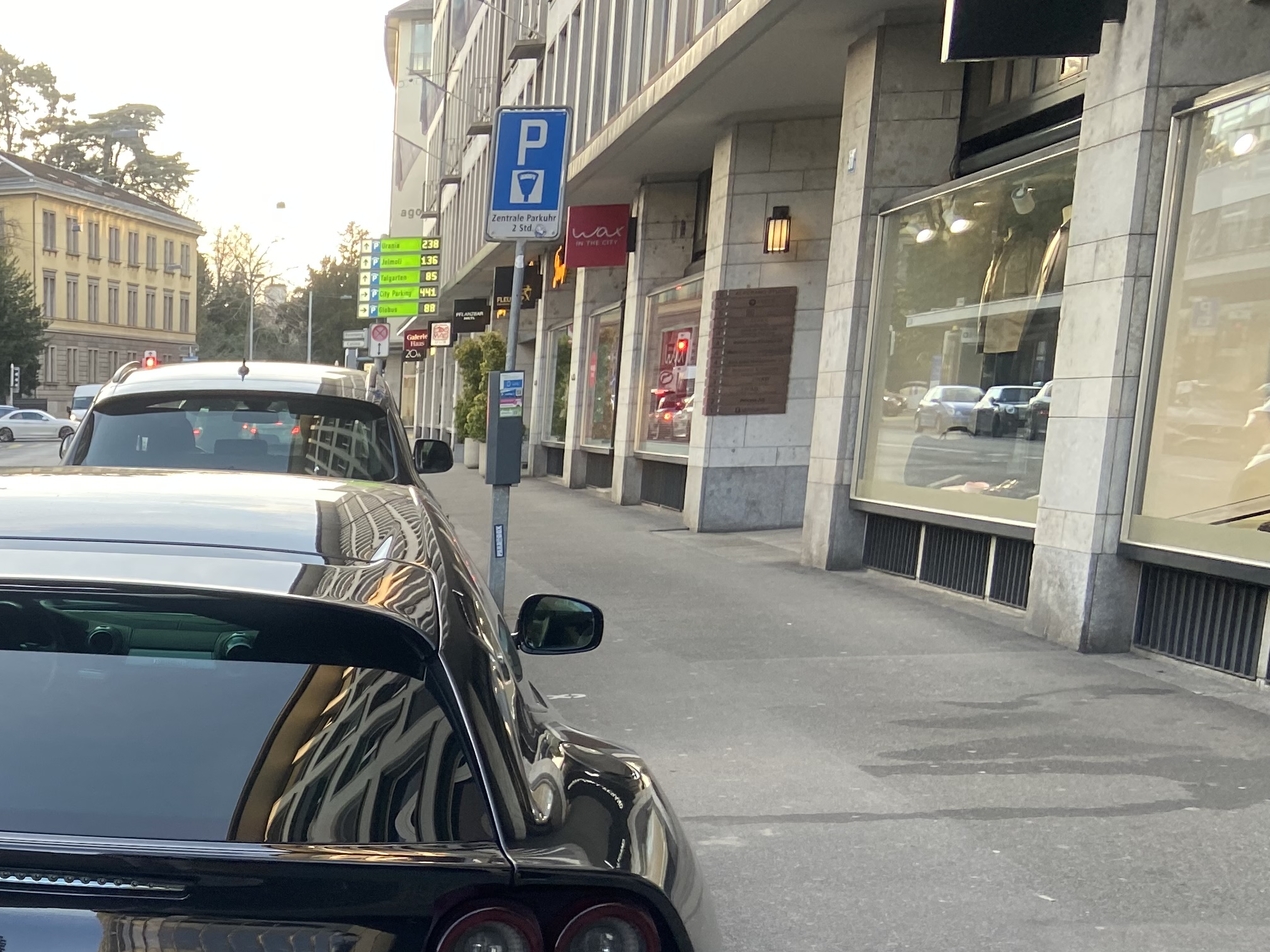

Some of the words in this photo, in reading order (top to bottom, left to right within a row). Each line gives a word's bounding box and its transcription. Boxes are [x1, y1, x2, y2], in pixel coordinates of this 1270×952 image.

[517, 119, 548, 166] P
[400, 208, 422, 219] ago
[491, 214, 524, 222] Zentrale
[526, 214, 557, 222] Parkuhr
[512, 224, 517, 232] 2
[572, 226, 625, 239] wax
[421, 240, 439, 249] 238
[421, 256, 438, 265] 136
[381, 274, 407, 282] Talgarten
[425, 271, 438, 281] 85
[379, 290, 390, 298] City
[391, 290, 412, 298] Parking
[419, 288, 437, 297] 441
[423, 304, 436, 313] 88
